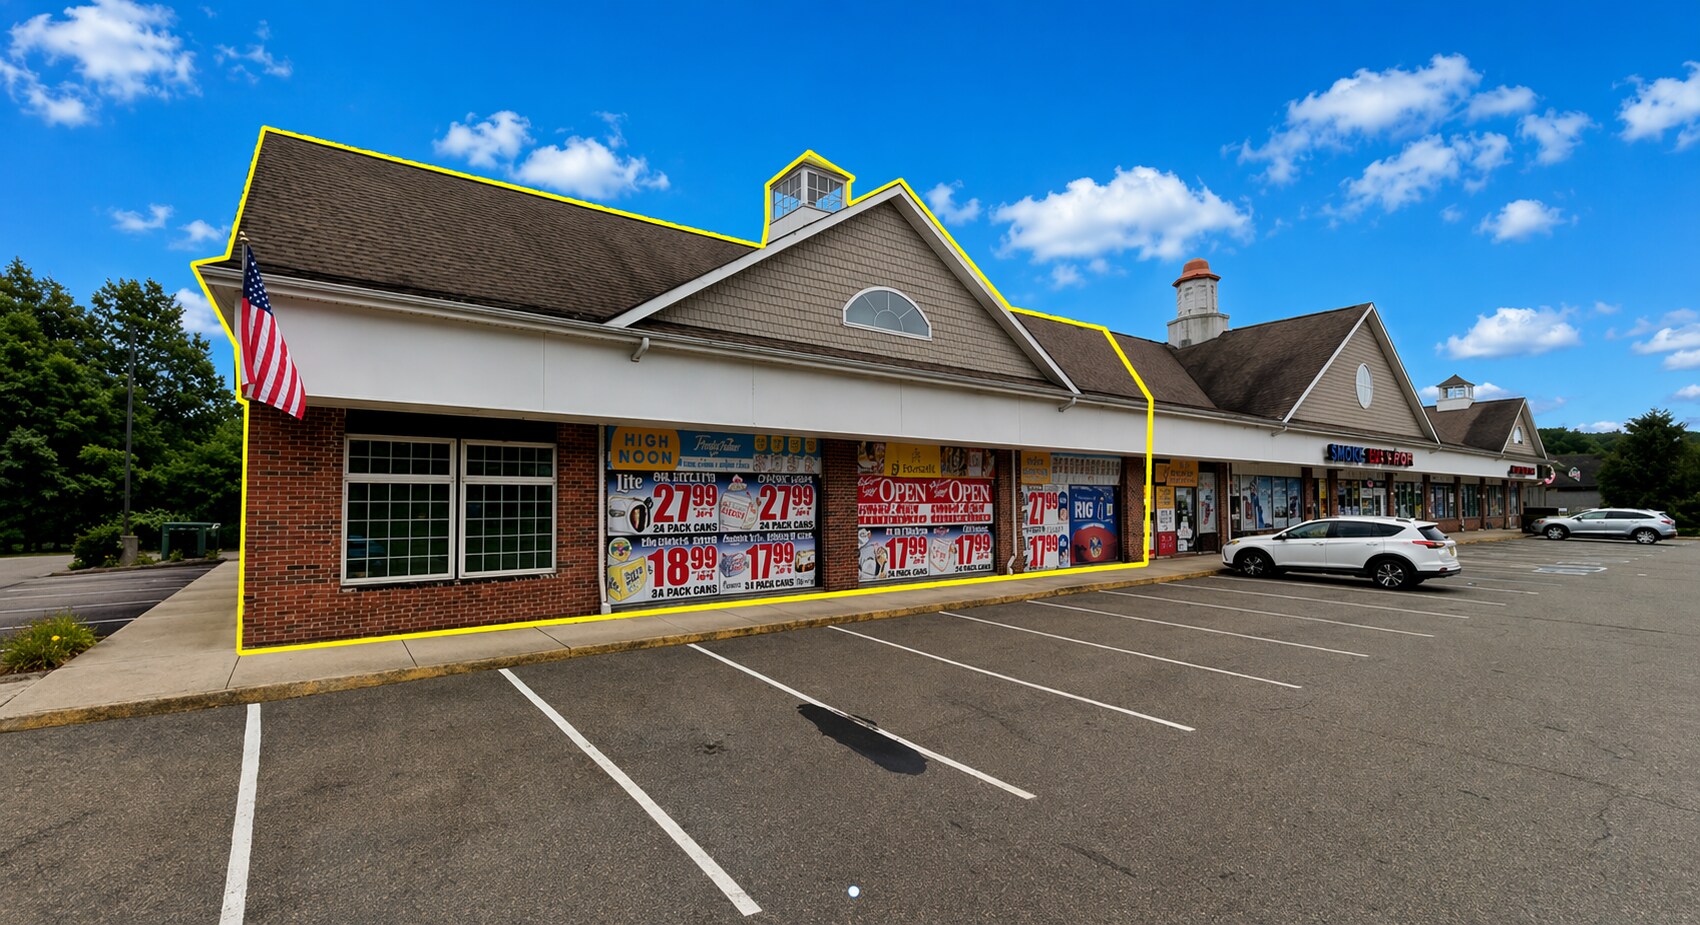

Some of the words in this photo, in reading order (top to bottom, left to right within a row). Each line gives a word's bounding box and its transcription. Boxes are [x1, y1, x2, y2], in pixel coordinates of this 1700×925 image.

[624, 432, 669, 448] HIGH
[618, 449, 672, 465] NOON
[616, 473, 643, 493] Lite
[879, 478, 927, 503] OPEN
[949, 479, 990, 503] OPEN
[653, 524, 665, 533] 24
[667, 523, 692, 533] PACK
[693, 522, 718, 532] CANS
[760, 521, 770, 530] 24
[666, 586, 692, 597] PACK
[693, 584, 718, 595] CANS
